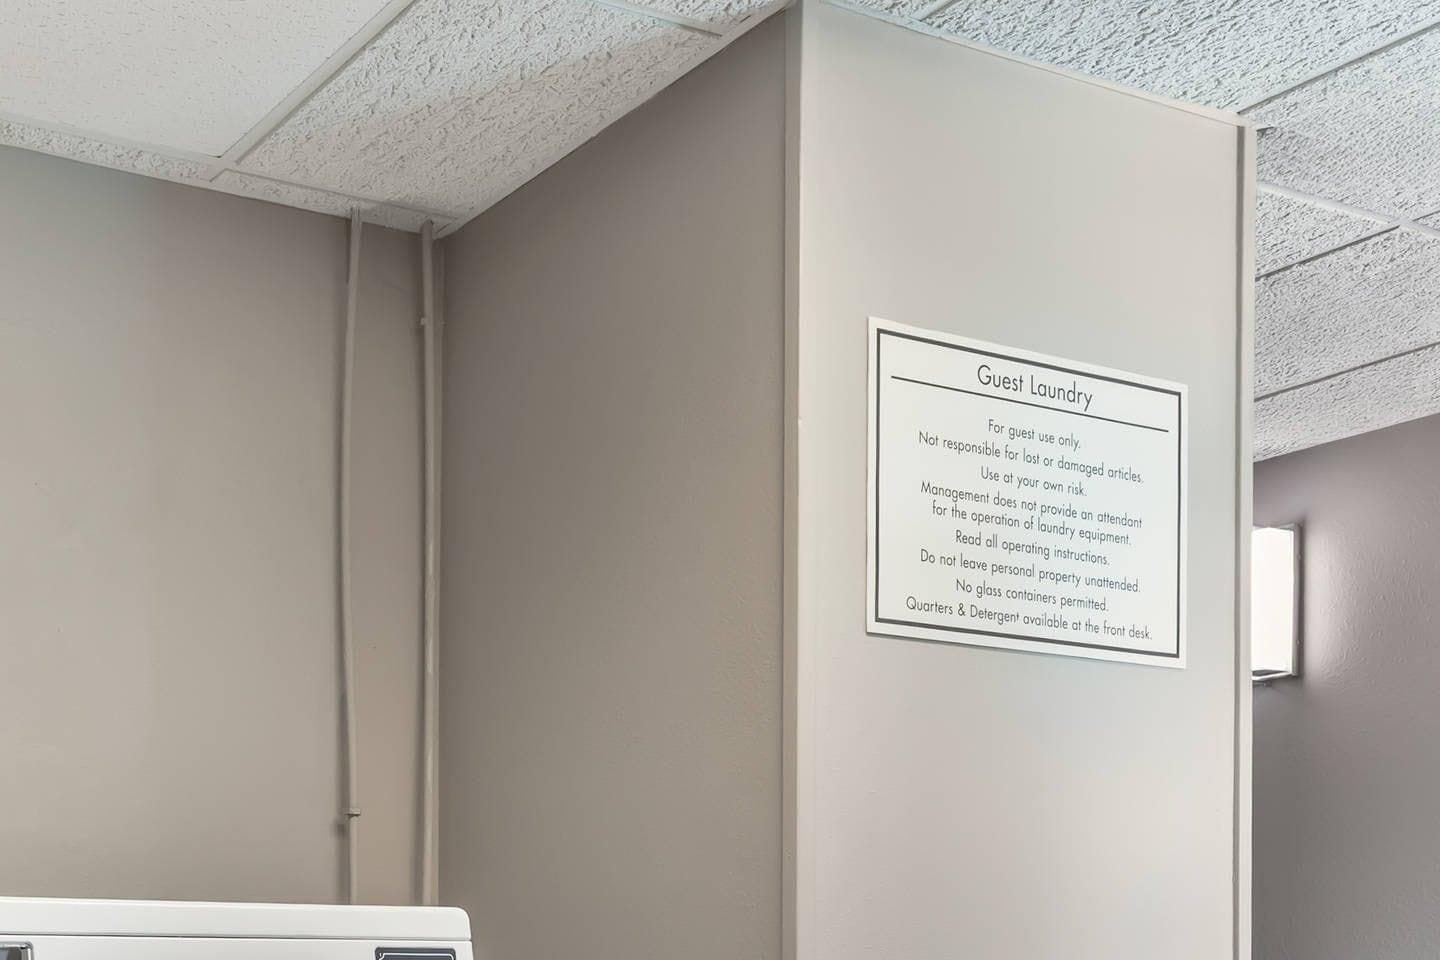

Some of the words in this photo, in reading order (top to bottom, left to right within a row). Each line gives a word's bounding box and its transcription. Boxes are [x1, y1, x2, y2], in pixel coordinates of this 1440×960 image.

[977, 364, 1024, 392] Guest
[1030, 374, 1093, 412] Laundry
[919, 430, 939, 446] Not
[943, 439, 1000, 458] responsible
[1005, 444, 1019, 460] for
[1023, 448, 1040, 464] lost
[1043, 457, 1054, 467] or
[1057, 455, 1104, 478] damaged
[1107, 466, 1144, 483] articles.
[988, 418, 1004, 434] For
[1008, 426, 1035, 440] guest
[1039, 432, 1055, 444] use
[1058, 432, 1081, 452] only.
[981, 465, 1000, 481] Use
[1003, 472, 1014, 483] at
[1017, 476, 1039, 489] your
[1043, 480, 1064, 492] own
[1067, 481, 1087, 496] risk.
[920, 480, 989, 504] Management
[993, 491, 1017, 509] does
[1021, 500, 1037, 511] not
[1040, 504, 1077, 518] provide
[1081, 510, 1093, 521] an
[1097, 511, 1142, 528] attendant
[932, 499, 947, 516] for
[951, 504, 967, 520] the
[971, 512, 1020, 528] operation
[1024, 515, 1034, 530] of
[1037, 517, 1075, 540] laundry
[1079, 528, 1131, 545] equipment.
[955, 529, 981, 546] Read
[986, 533, 998, 548] all
[1001, 541, 1050, 560] operating
[1054, 545, 1110, 565] instructions.
[920, 548, 935, 563] Do
[940, 555, 956, 568] not
[960, 552, 987, 571] leave
[991, 563, 1035, 577] personal
[1039, 569, 1081, 588] property
[1085, 576, 1140, 593] unattended.
[956, 578, 972, 593] No
[976, 580, 1002, 598] glass
[1006, 589, 1056, 605] containers
[1060, 596, 1109, 612] permitted.
[906, 596, 953, 615] Quarters
[957, 602, 966, 616] &
[970, 604, 1019, 625] Detergent
[1023, 612, 1068, 629] available
[1072, 620, 1081, 631] at
[1085, 618, 1100, 633] the
[1103, 620, 1125, 637] front
[1128, 624, 1152, 640] desk.
